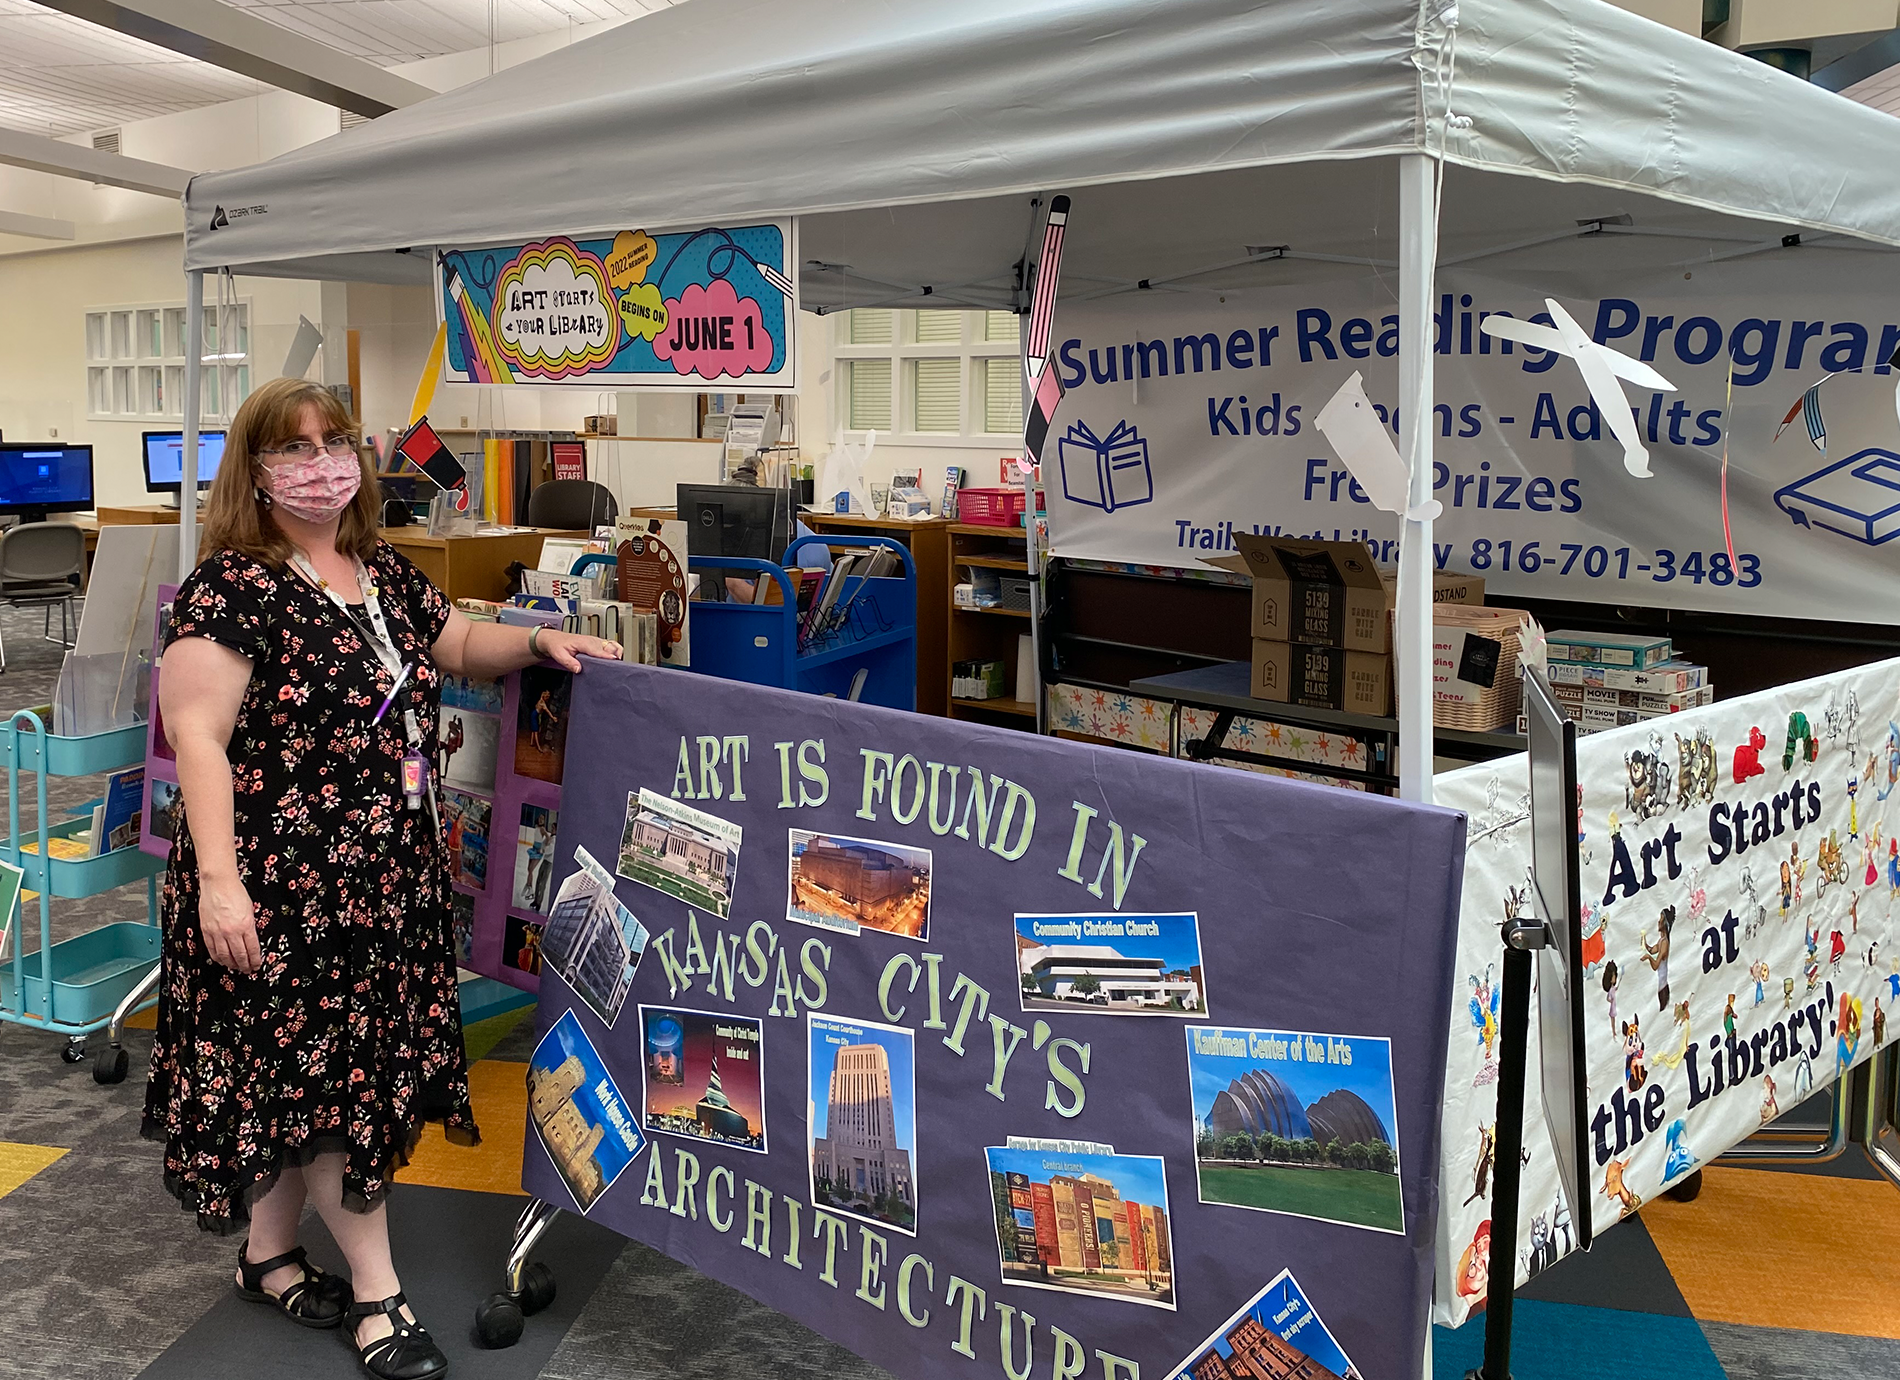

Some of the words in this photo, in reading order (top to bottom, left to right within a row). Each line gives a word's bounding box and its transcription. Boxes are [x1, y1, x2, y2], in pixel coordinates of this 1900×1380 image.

[610, 256, 629, 278] 2022
[627, 242, 648, 260] SUMMER
[628, 252, 649, 270] READING
[511, 290, 548, 312] ART
[621, 300, 651, 320] BEGINS
[652, 308, 665, 325] ON
[669, 316, 735, 351] JUNE
[743, 316, 754, 350] 1
[1059, 325, 1280, 390] Summer
[1207, 392, 1302, 437] Kids
[558, 471, 581, 480] STAFF
[1303, 458, 1371, 503] Fre
[1469, 538, 1763, 588] 816-701-3483
[1305, 590, 1329, 608] 5139
[1305, 607, 1329, 620] MIXING
[1304, 619, 1328, 633] GLASS
[1305, 653, 1329, 672] 5139
[1305, 670, 1329, 683] MIXING
[1304, 681, 1328, 696] GLASS
[1437, 691, 1464, 701] Teens
[1555, 691, 1582, 699] PUZZLE
[1587, 689, 1616, 699] MOVIE
[1594, 709, 1616, 717] SHOW
[1642, 702, 1668, 710] PUZZLES
[641, 793, 653, 804] The
[653, 797, 694, 822] Nelson-Atkins
[693, 813, 721, 831] Museum
[721, 824, 729, 833] of
[729, 828, 740, 839] Art
[670, 735, 749, 802] ART
[773, 738, 830, 810] IS
[855, 747, 1037, 862] FOUND
[1057, 799, 1148, 910] IN
[1602, 823, 1682, 907] Art
[1706, 778, 1822, 866] Starts
[1033, 921, 1082, 940] Community
[1083, 920, 1124, 937] Christian
[1125, 920, 1160, 937] Church
[1701, 909, 1740, 975] at
[652, 909, 832, 1018] KANSAS
[877, 952, 1091, 1119] CITY'S
[811, 1020, 828, 1031] Jackson
[826, 1035, 840, 1045] Kansas
[840, 1037, 850, 1047] City
[1193, 1029, 1247, 1058] Kauffman
[1249, 1031, 1288, 1060] Center
[1291, 1034, 1302, 1062] of
[1304, 1035, 1325, 1063] the
[1327, 1037, 1352, 1065] Arts
[1590, 1082, 1667, 1168] the
[1684, 980, 1837, 1111] Library!
[594, 1077, 614, 1107] Work
[604, 1097, 625, 1129] House
[618, 1121, 639, 1152] Castle
[1037, 1140, 1058, 1152] Kansas
[1058, 1141, 1071, 1154] City
[1071, 1141, 1089, 1155] Public
[1042, 1158, 1063, 1172] Central
[1063, 1160, 1084, 1174] branch
